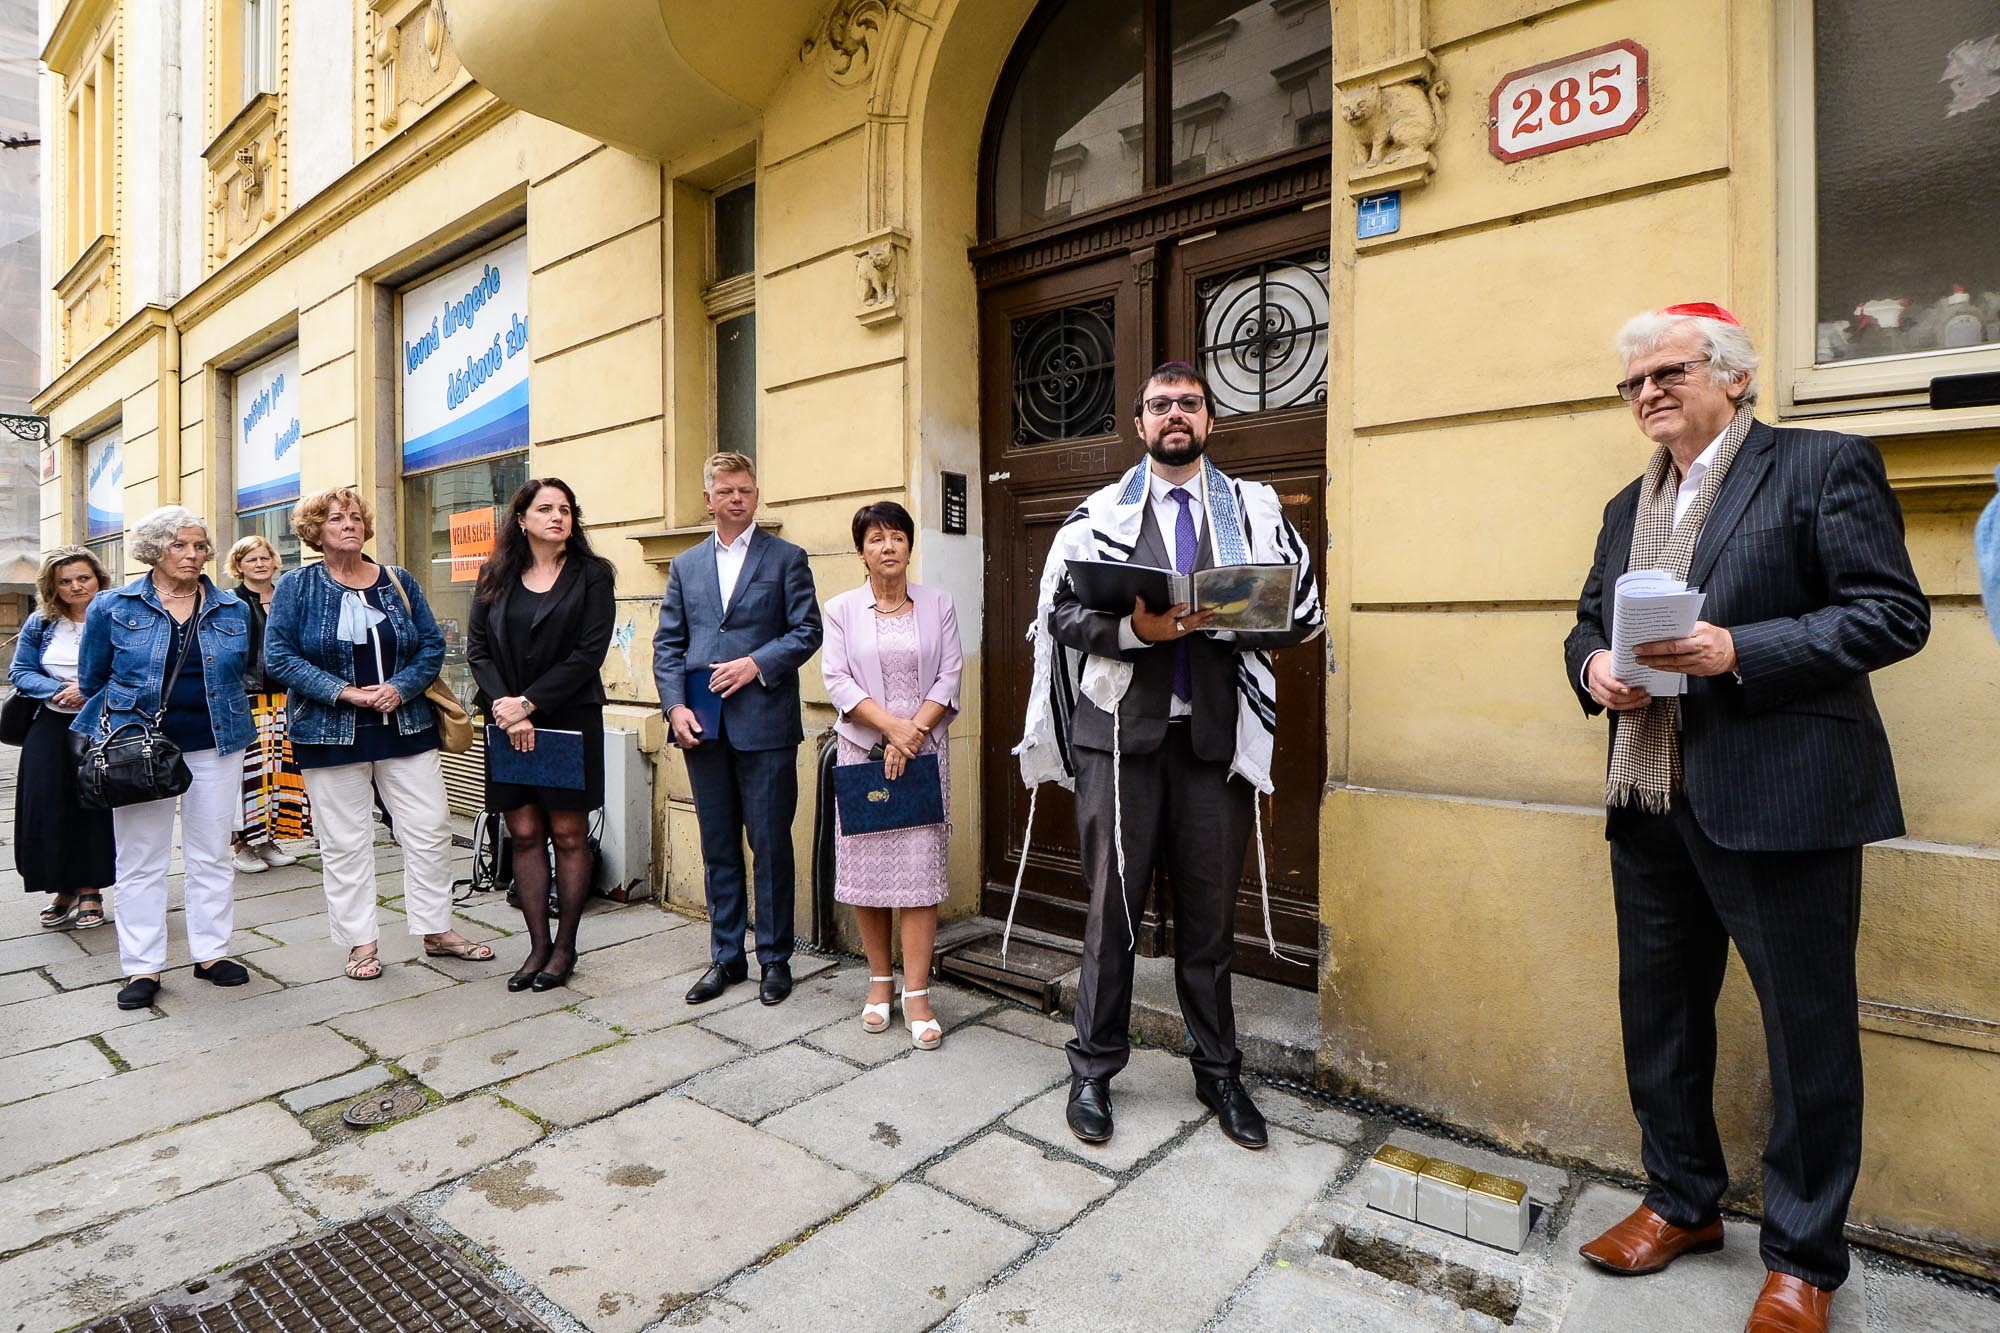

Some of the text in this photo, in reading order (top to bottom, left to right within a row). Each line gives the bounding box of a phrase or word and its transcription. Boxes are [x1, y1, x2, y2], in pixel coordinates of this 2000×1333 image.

[1512, 64, 1621, 139] 285
[405, 264, 501, 375] levná drogerie
[271, 373, 285, 410] pro
[447, 332, 503, 410] dárkové
